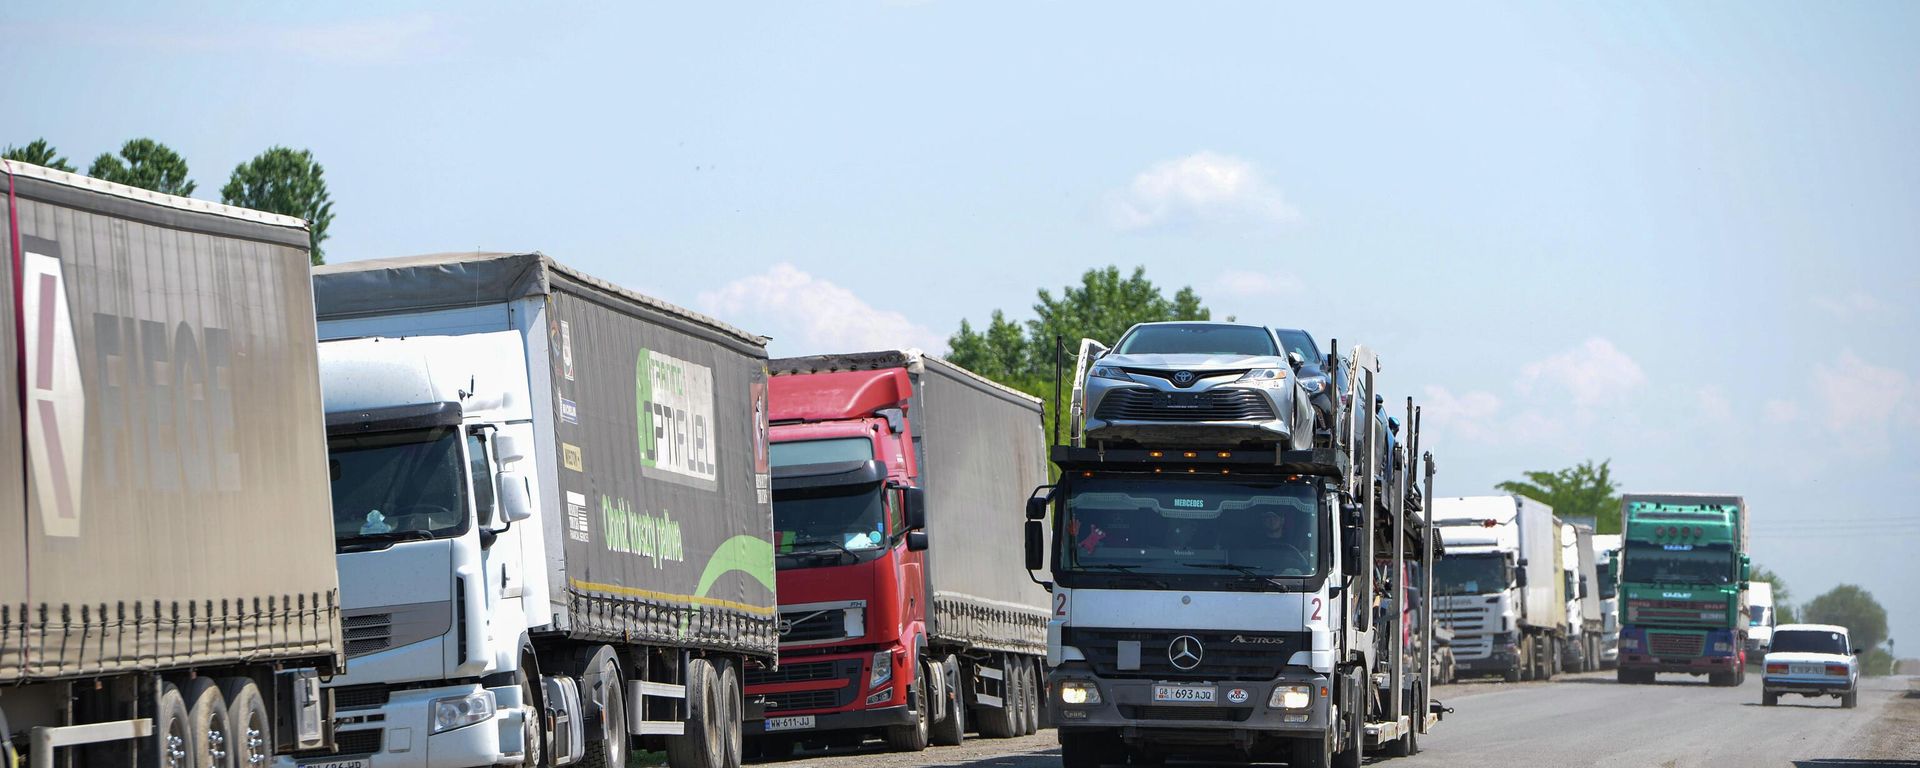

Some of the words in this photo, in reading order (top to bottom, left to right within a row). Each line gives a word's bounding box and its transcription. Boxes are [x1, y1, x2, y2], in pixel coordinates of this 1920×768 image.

[93, 312, 241, 494] FIEGE
[643, 400, 715, 475] OPTIFUEL
[1174, 498, 1204, 508] MERCEDES
[1055, 593, 1066, 616] 2
[1311, 597, 1322, 621] 2
[1175, 689, 1194, 700] 693
[1195, 691, 1212, 700] AJQ
[770, 716, 811, 729] WW-611-JJ
